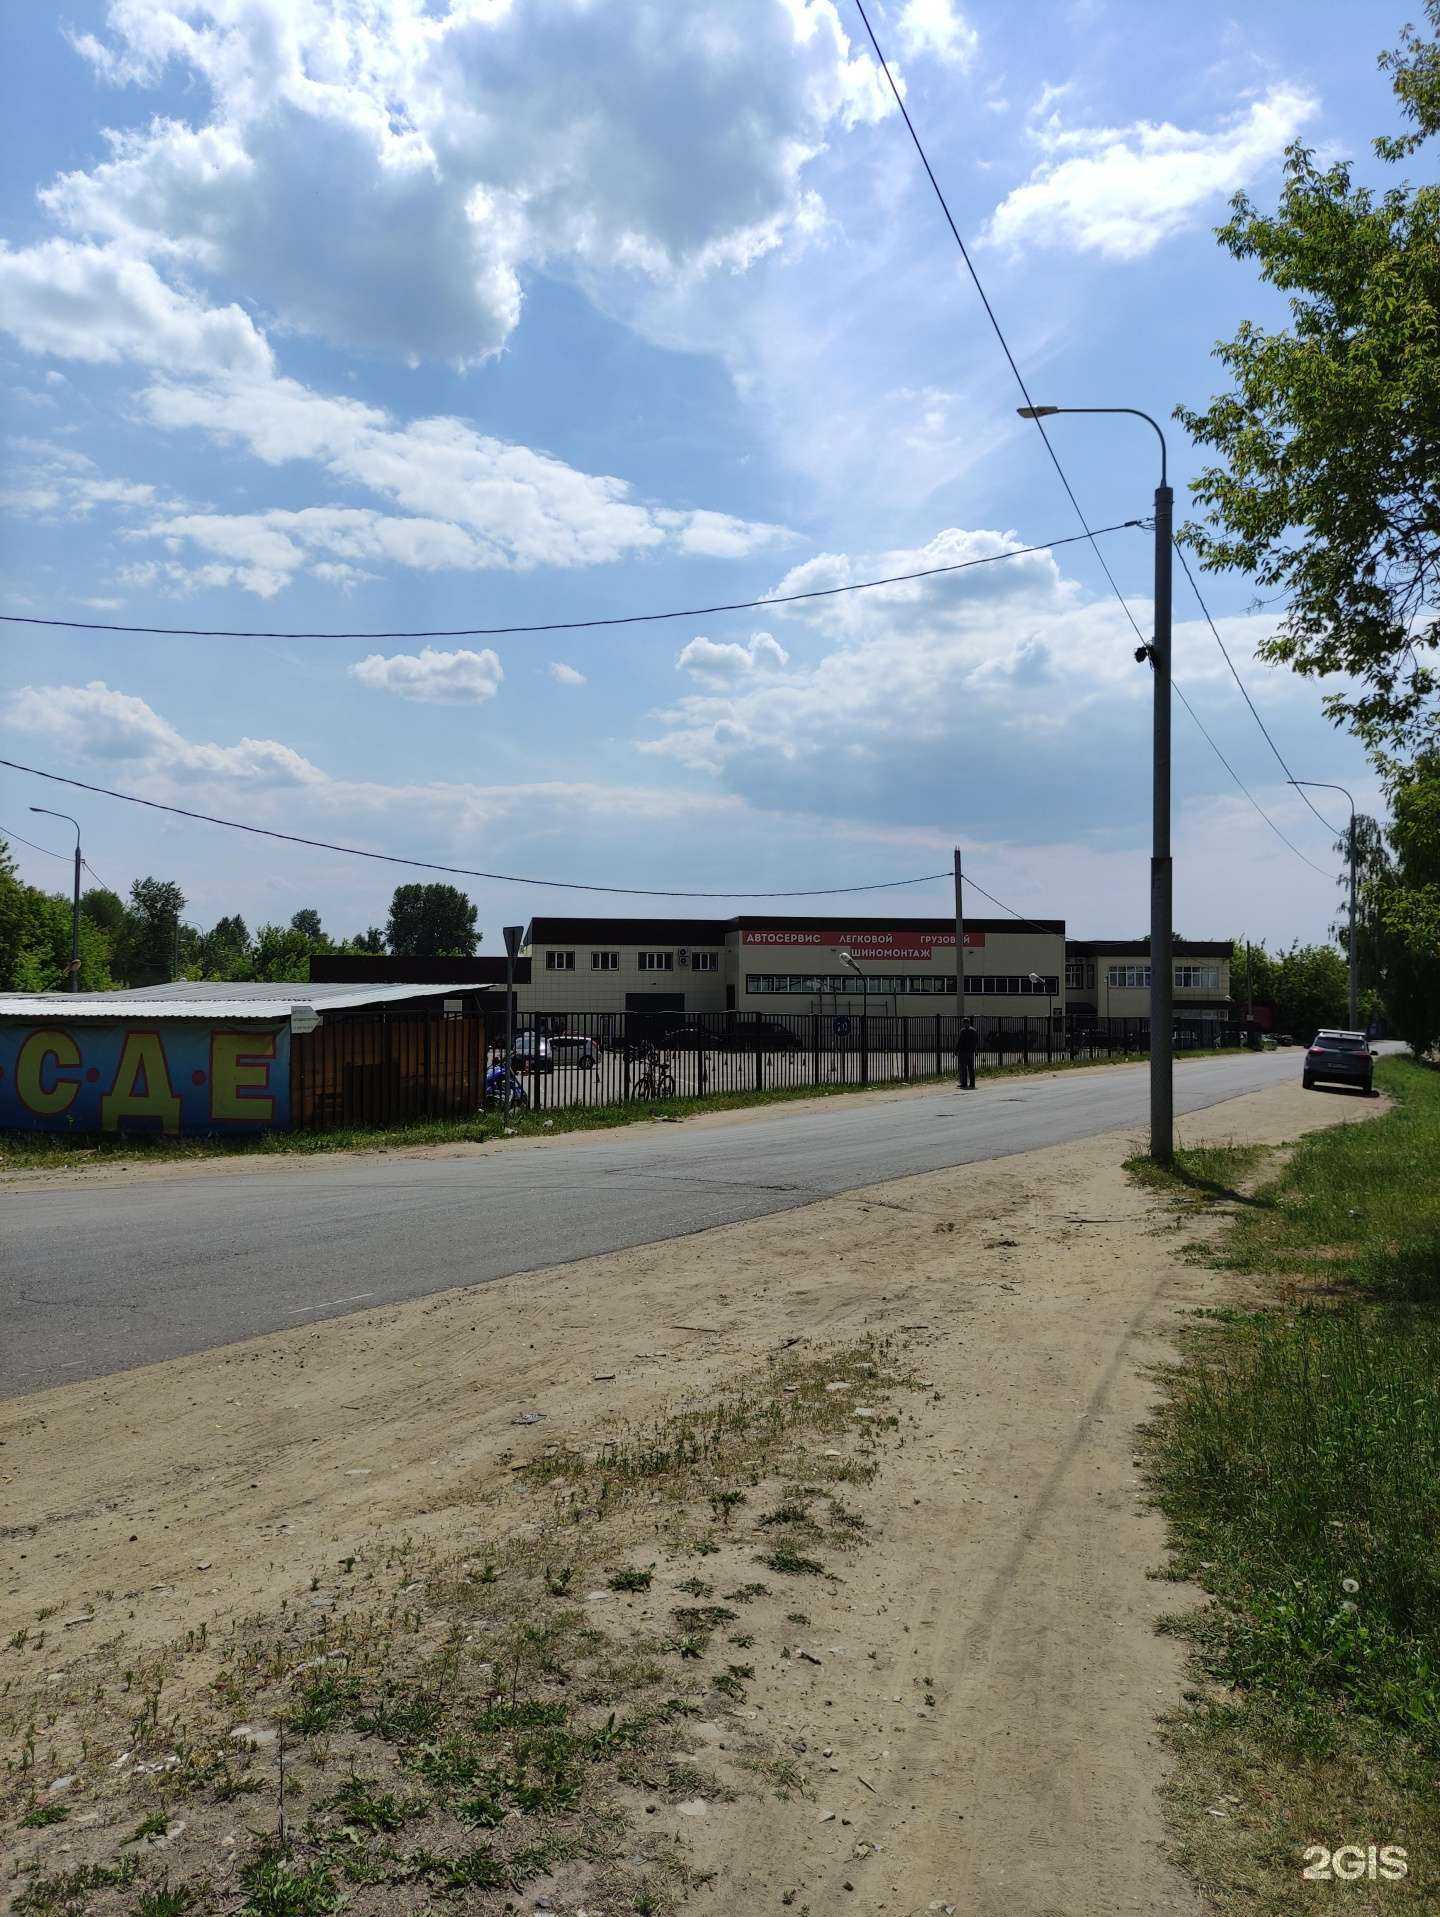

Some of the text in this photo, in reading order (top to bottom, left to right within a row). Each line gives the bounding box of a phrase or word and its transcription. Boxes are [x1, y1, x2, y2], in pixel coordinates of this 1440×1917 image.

[746, 932, 970, 944] АВТОСЕРВИС ЛЕГКОВОЙ ГРУЗОВЙ
[851, 948, 930, 957] ШИНОМОНТАЖ
